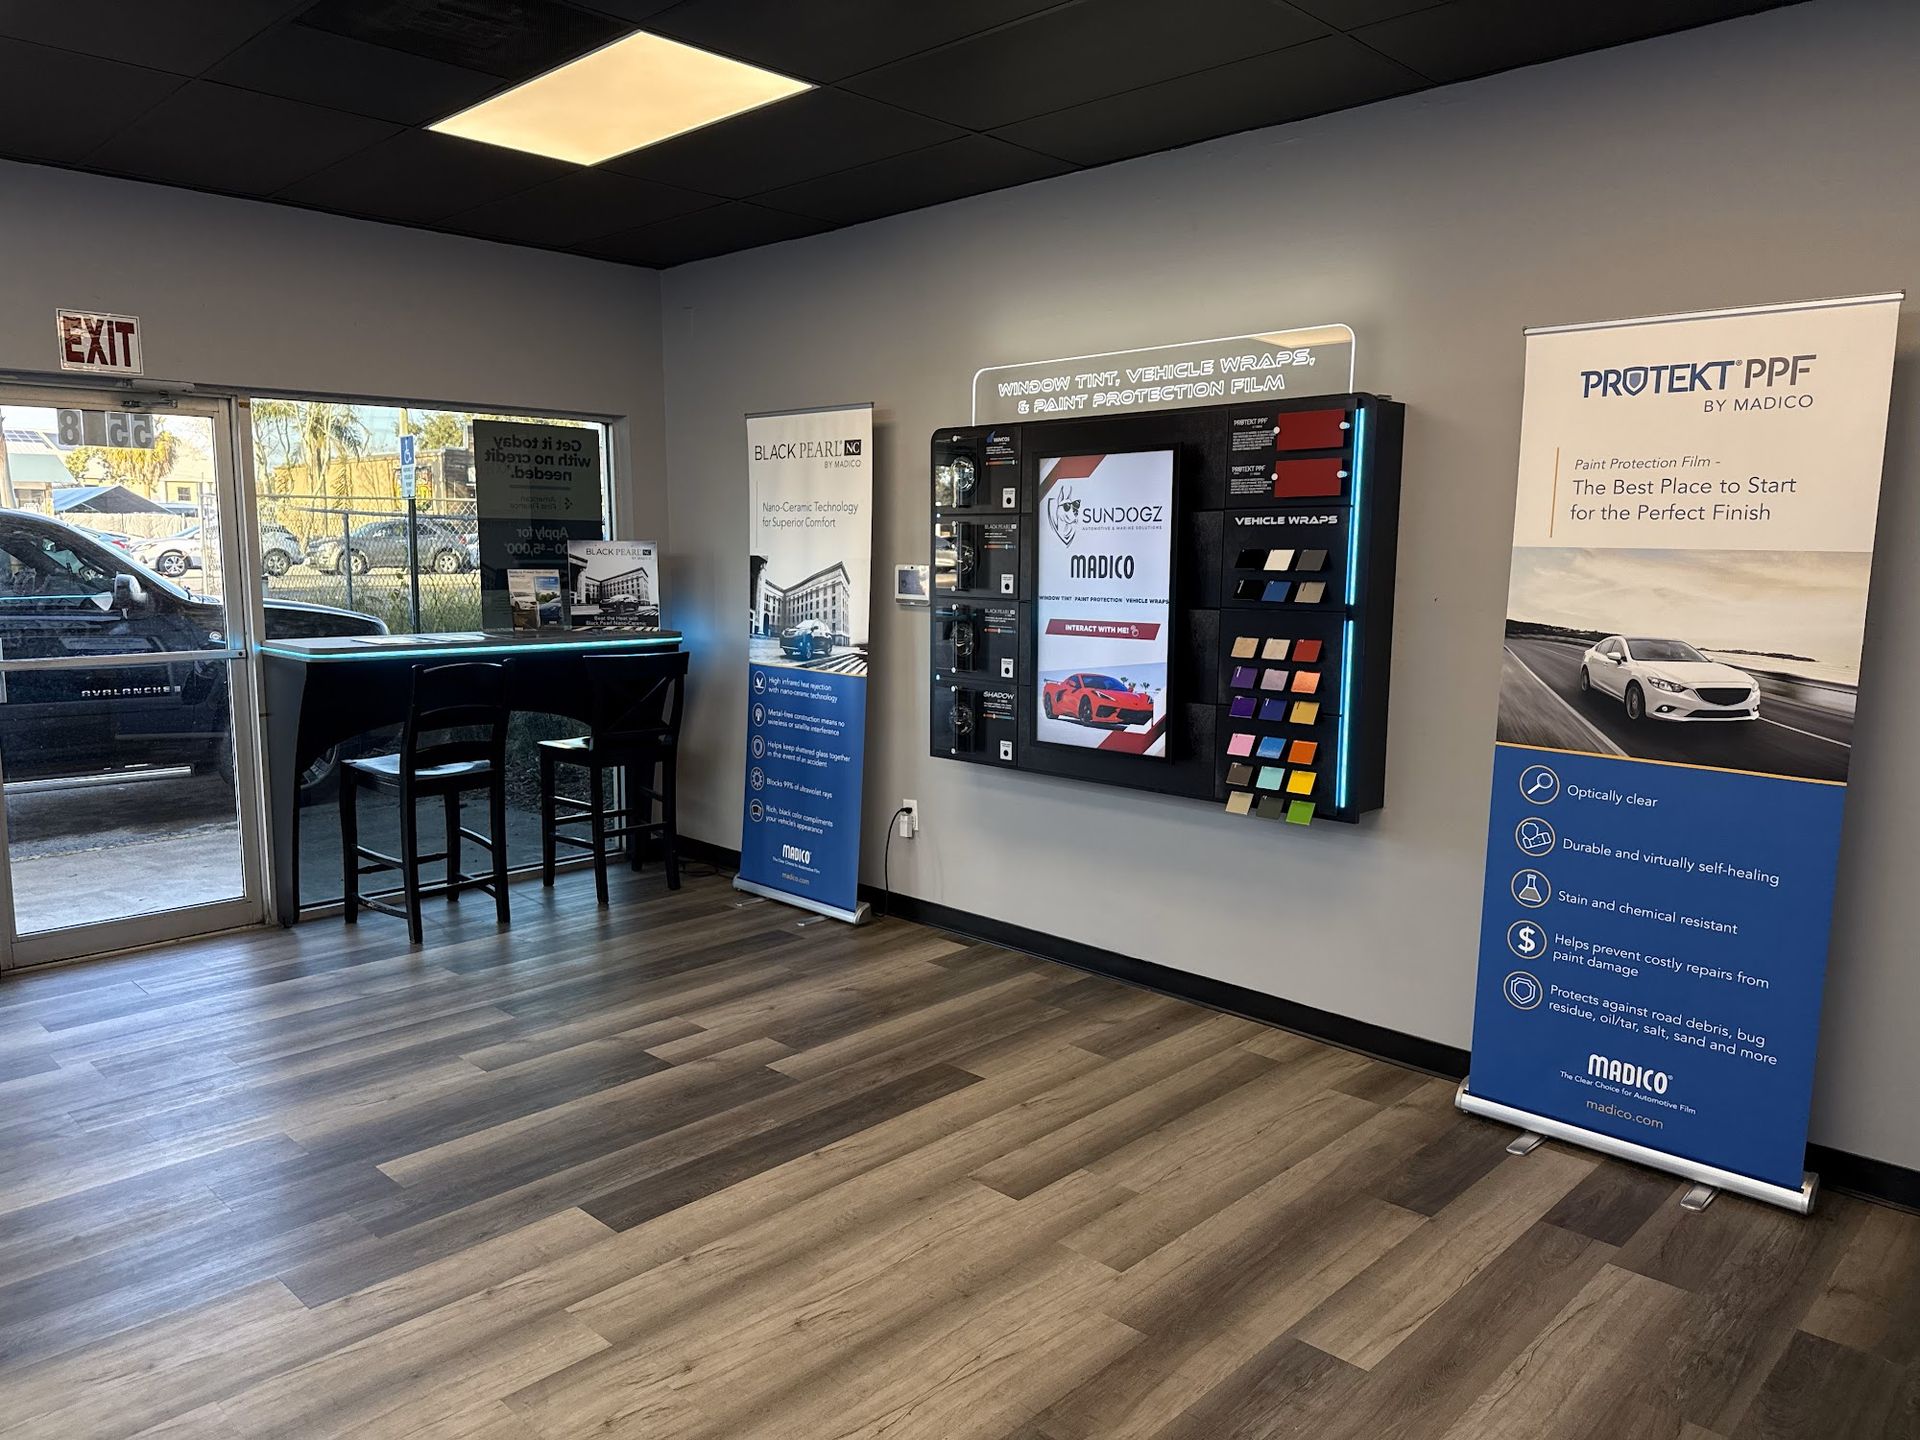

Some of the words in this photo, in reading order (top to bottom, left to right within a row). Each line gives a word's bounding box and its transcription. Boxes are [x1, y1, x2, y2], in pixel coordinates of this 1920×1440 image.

[62, 316, 135, 368] EXIT
[998, 376, 1070, 397] WINDOW
[1075, 371, 1120, 389] TINT,
[1126, 360, 1214, 383] VEHICLE
[1220, 349, 1315, 374] WRAPS,
[1744, 354, 1817, 389] PPF
[1018, 400, 1029, 414] &
[1034, 394, 1088, 413] PAINT
[1092, 380, 1224, 408] PROTECTION
[1231, 374, 1285, 395] FILM
[1704, 400, 1727, 413] BY
[1734, 394, 1814, 411] MADICO
[755, 443, 796, 460] BLACK
[845, 441, 860, 454] NC
[1574, 459, 1606, 470] Paint
[1610, 457, 1676, 469] Protection
[1681, 456, 1710, 468] Film
[1573, 479, 1606, 495] The
[1613, 479, 1654, 495] Best
[1660, 478, 1712, 494] Place
[1720, 480, 1740, 494] to
[1748, 476, 1797, 493] Start
[762, 501, 812, 512] Nano-Ceramic
[814, 501, 859, 514] Technology
[1082, 506, 1163, 523] SUNDOGZ
[1570, 504, 1595, 521] for
[1601, 505, 1631, 521] the
[1637, 503, 1706, 520] Perfect
[1712, 503, 1771, 520] Finish
[762, 516, 771, 527] for
[772, 517, 803, 529] Superior
[805, 516, 835, 527] Comfort
[1235, 516, 1285, 525] VEHICLE
[1288, 516, 1338, 525] WRAPS
[586, 548, 614, 556] BLACK
[1070, 555, 1135, 579] MADICO
[1065, 624, 1097, 632] INTERACT
[1117, 626, 1129, 634] ME!
[82, 686, 170, 696] AVALANCHE
[983, 691, 1014, 699] SHADOW
[1567, 785, 1623, 805] Optically
[1626, 793, 1658, 807] clear
[782, 844, 810, 864] MADICO
[1563, 838, 1612, 856] Durable
[1615, 848, 1640, 861] and
[1643, 853, 1695, 872] virtually
[1699, 862, 1780, 888] self-healing
[1558, 891, 1588, 906] Stain
[1591, 898, 1615, 911] and
[1619, 903, 1676, 923] chemical
[1680, 916, 1738, 935] resistant
[1553, 951, 1584, 966] paint
[1587, 956, 1639, 978] damage
[1555, 933, 1590, 951] Helps
[1593, 943, 1641, 962] prevent
[1644, 954, 1683, 973] costly
[1686, 962, 1733, 981] repairs
[1737, 971, 1770, 989] from
[1550, 984, 1599, 1006] Protects
[1602, 998, 1648, 1018] against
[1651, 1009, 1682, 1025] road
[1685, 1017, 1733, 1040] debris,
[1737, 1028, 1766, 1048] bug
[1549, 1001, 1597, 1022] residue,
[1600, 1012, 1639, 1033] oil/tar,
[1643, 1022, 1670, 1040] salt,
[1673, 1031, 1706, 1048] sand
[1709, 1039, 1736, 1056] and
[1740, 1048, 1778, 1066] more
[1559, 1070, 1573, 1081] The
[1574, 1074, 1594, 1086] Clear
[1594, 1080, 1620, 1094] Choice
[1621, 1087, 1633, 1097] for
[1634, 1090, 1678, 1110] Automotive
[1679, 1103, 1696, 1115] Film
[1586, 1098, 1664, 1130] madico.com
